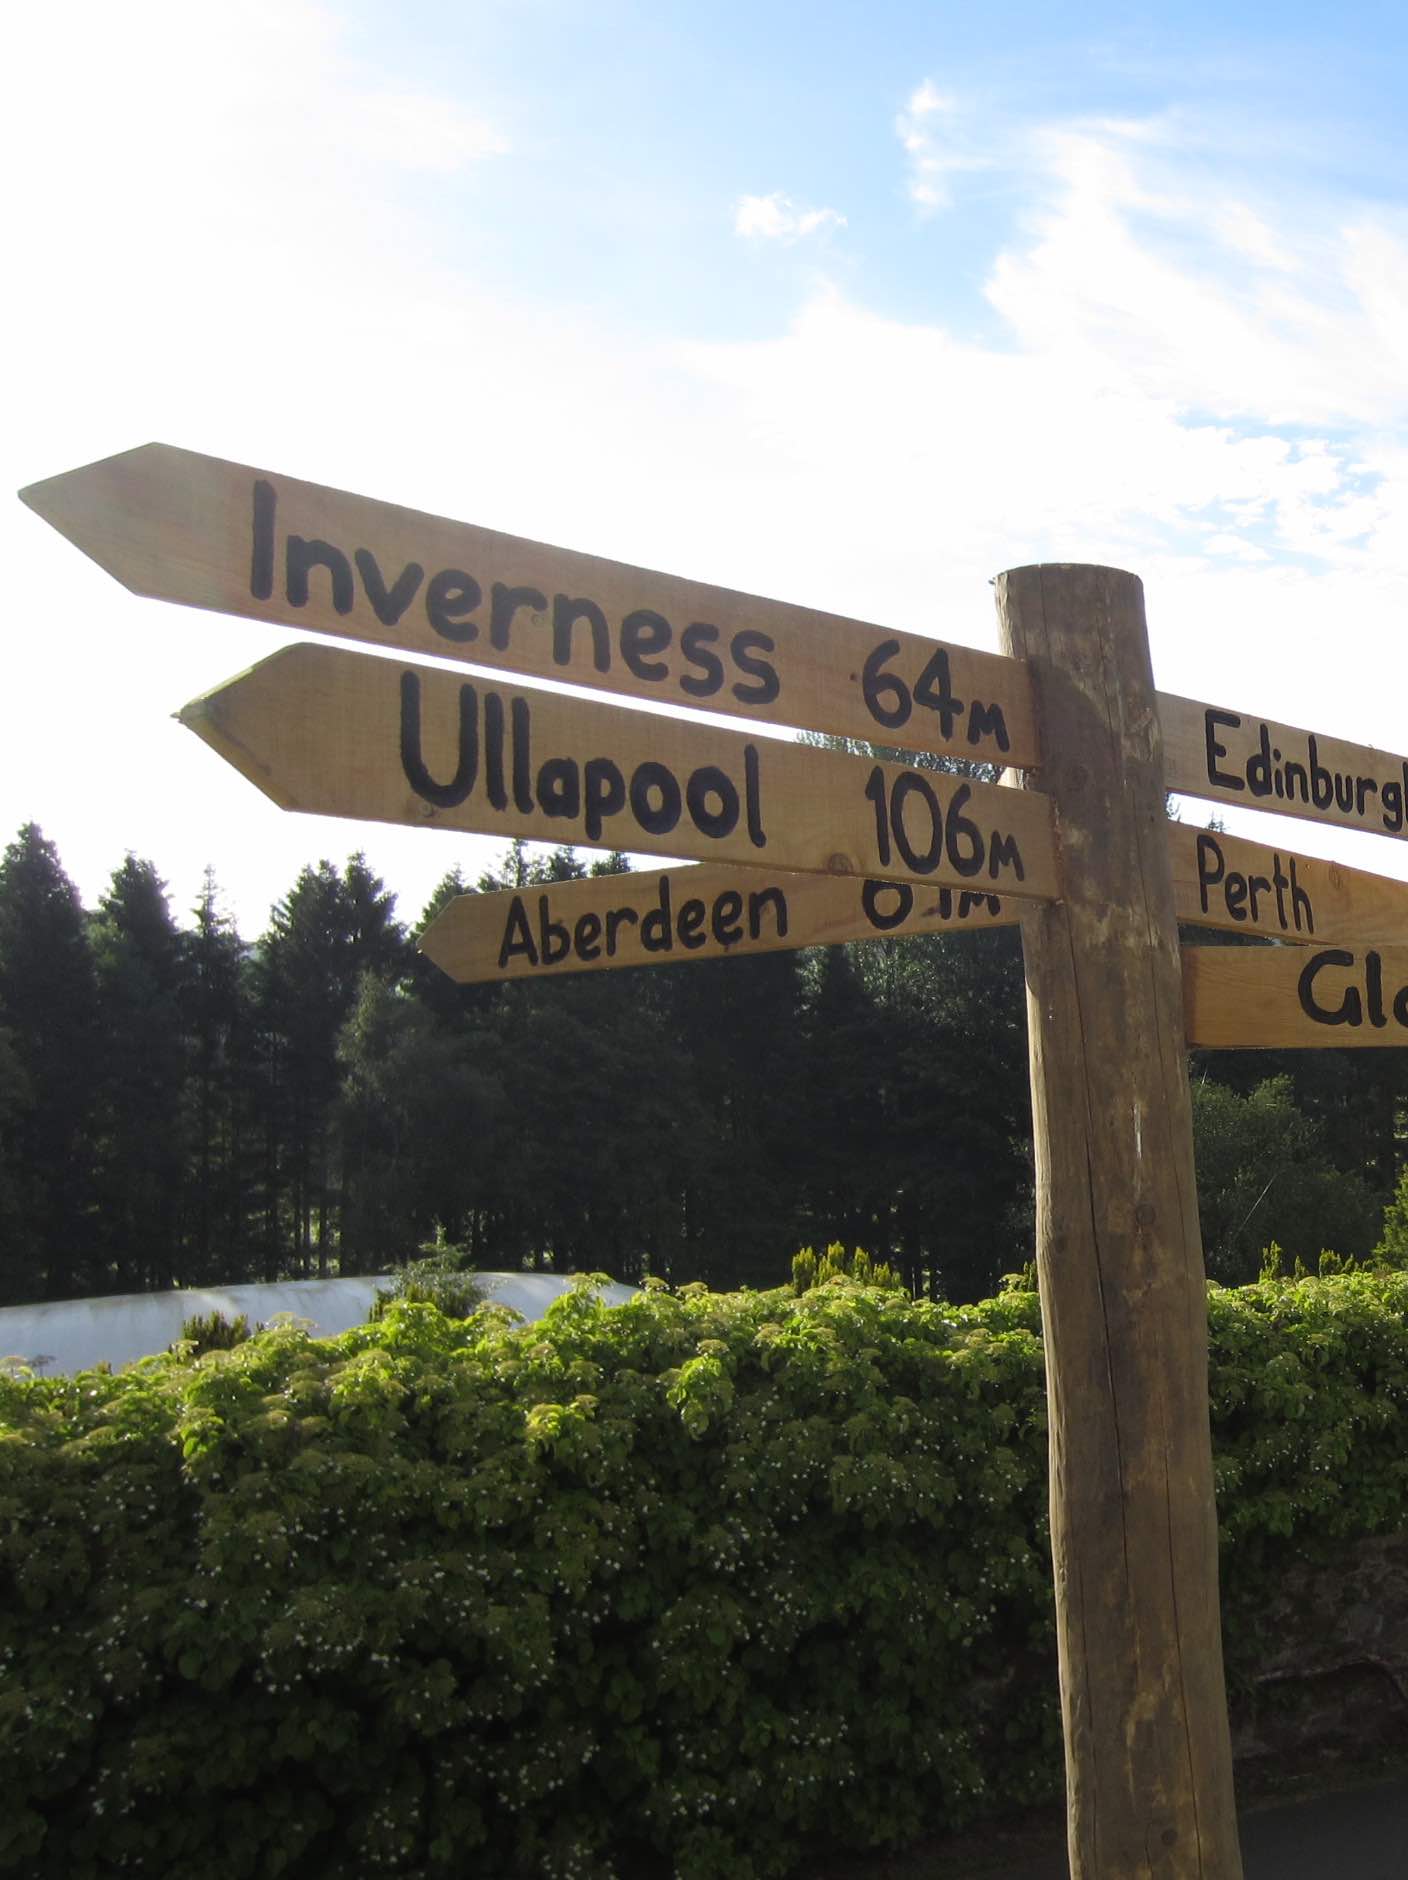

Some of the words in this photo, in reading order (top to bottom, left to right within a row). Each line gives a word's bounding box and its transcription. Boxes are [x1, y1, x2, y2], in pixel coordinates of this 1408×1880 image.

[251, 479, 781, 705] Inverness
[400, 670, 767, 848] Ullapool
[498, 874, 789, 969] Aberdeen
[1196, 834, 1315, 935] Perth
